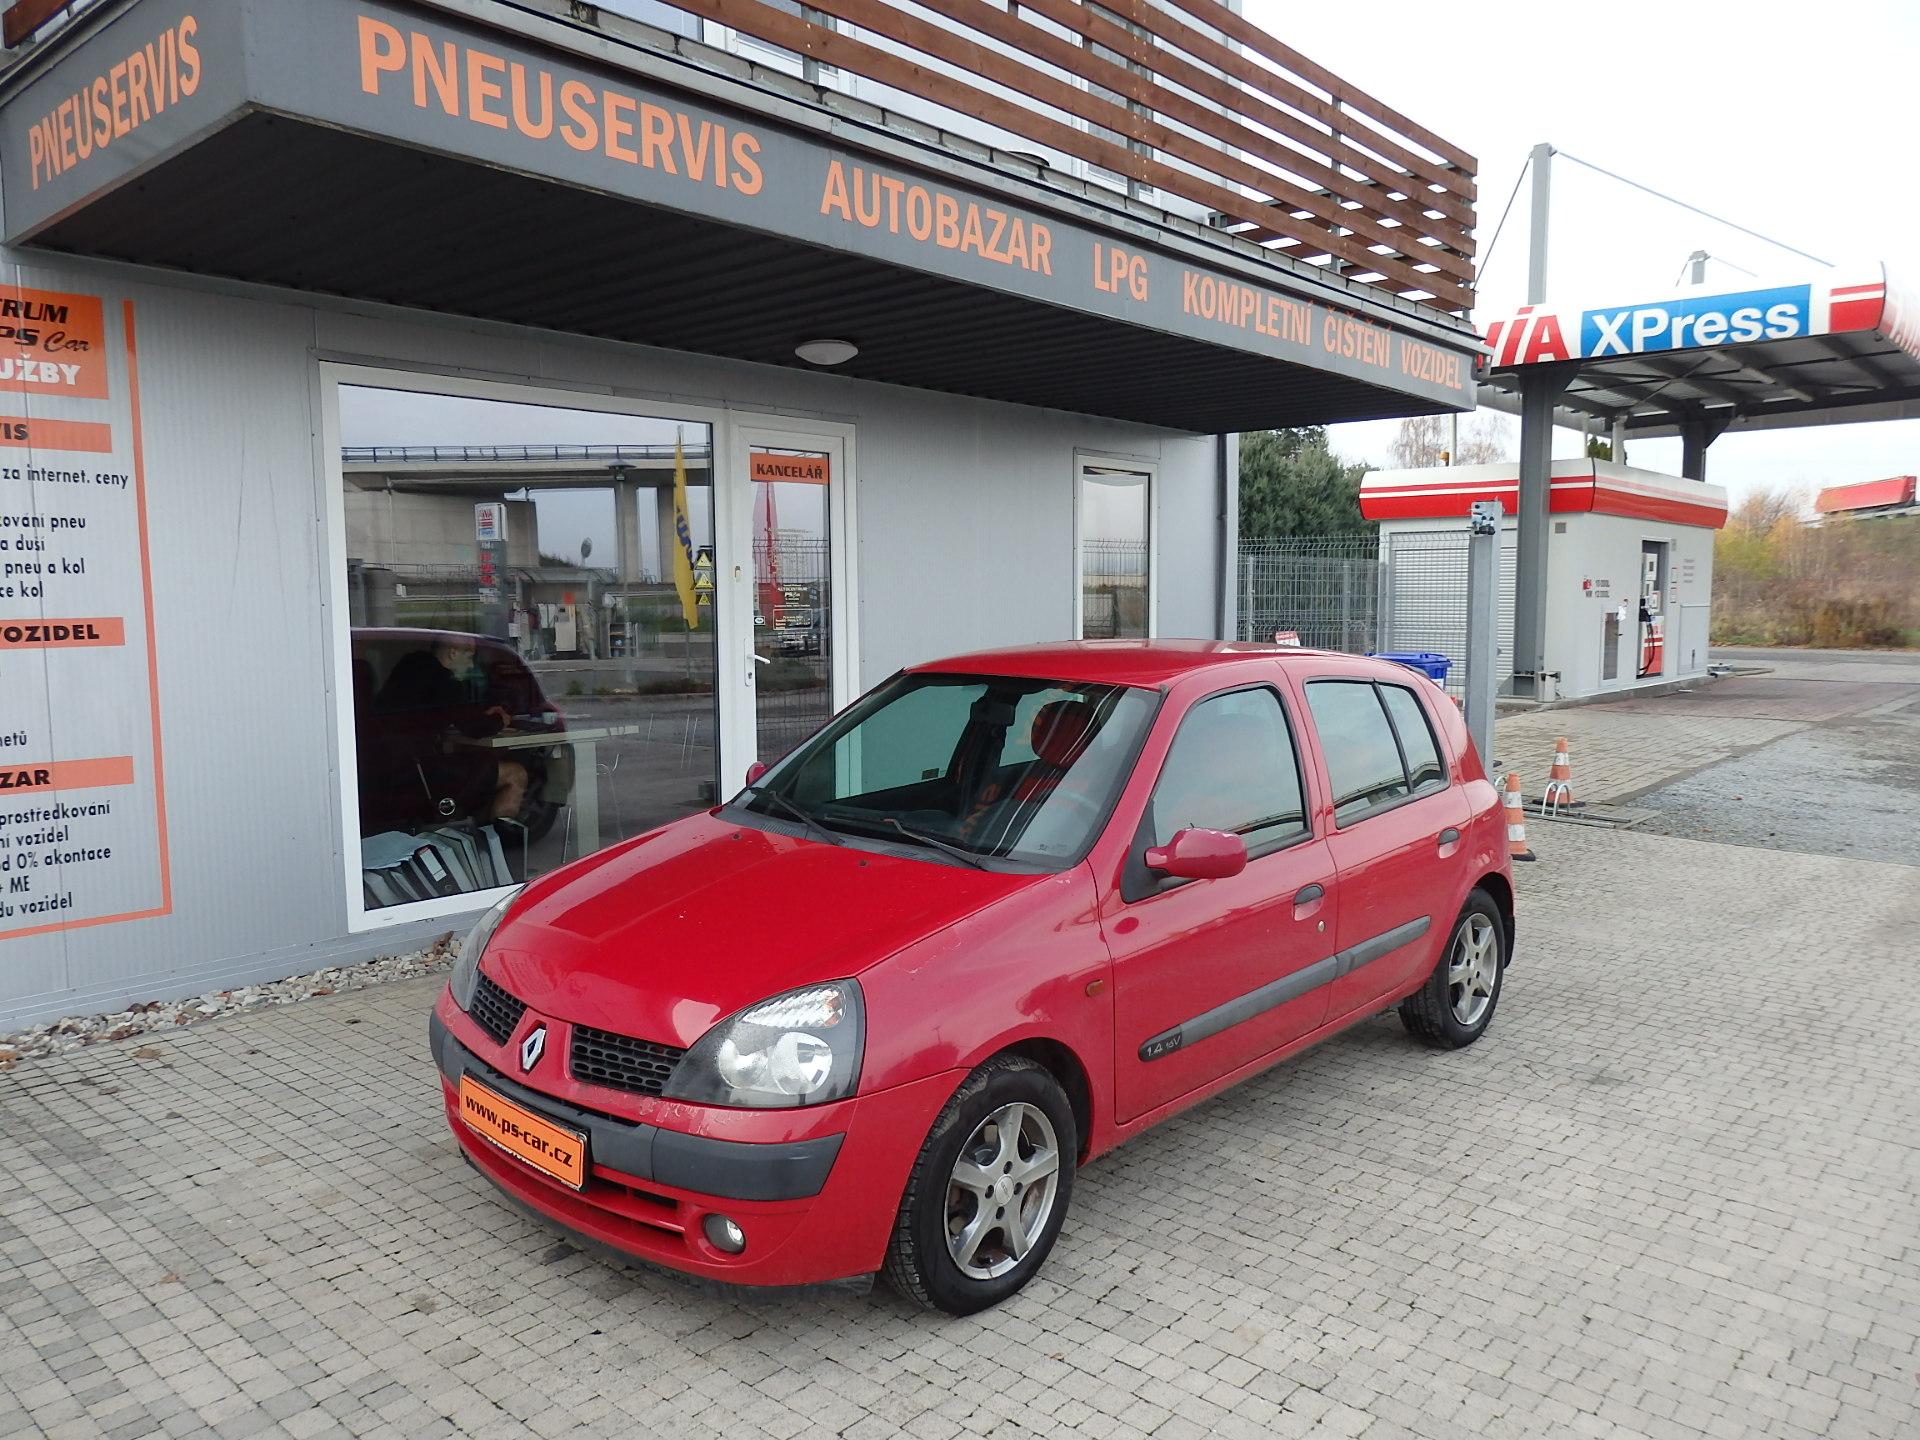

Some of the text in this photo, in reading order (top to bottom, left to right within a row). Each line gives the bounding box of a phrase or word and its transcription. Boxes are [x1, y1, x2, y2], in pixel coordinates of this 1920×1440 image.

[29, 14, 201, 190] PNEUSERVIS
[357, 15, 764, 196] PNEUSERVIS
[820, 161, 1463, 390] AUTOBAZAR LPG KOMPLETNÍ ČIŠTĚNÍ VOZIDEL
[0, 298, 69, 324] RUM
[1590, 302, 1799, 358] XPress
[44, 331, 91, 353] Car
[0, 423, 29, 441] IS
[3, 464, 129, 490] za internet. ceny
[756, 463, 823, 480] KANCELÁŘ
[0, 512, 87, 533] ování pneu
[16, 533, 46, 551] duší
[5, 557, 85, 579] pneu a kol
[20, 580, 44, 598] kol
[0, 624, 100, 643] OZIDEL
[0, 730, 28, 747] etů
[0, 769, 51, 788] ZAR
[16, 825, 70, 847] vozidel
[17, 851, 39, 869] 0%
[44, 847, 112, 866] akontace
[10, 875, 31, 893] ME
[20, 892, 73, 914] vozidel
[465, 1095, 573, 1168] www.ps-car.cz
